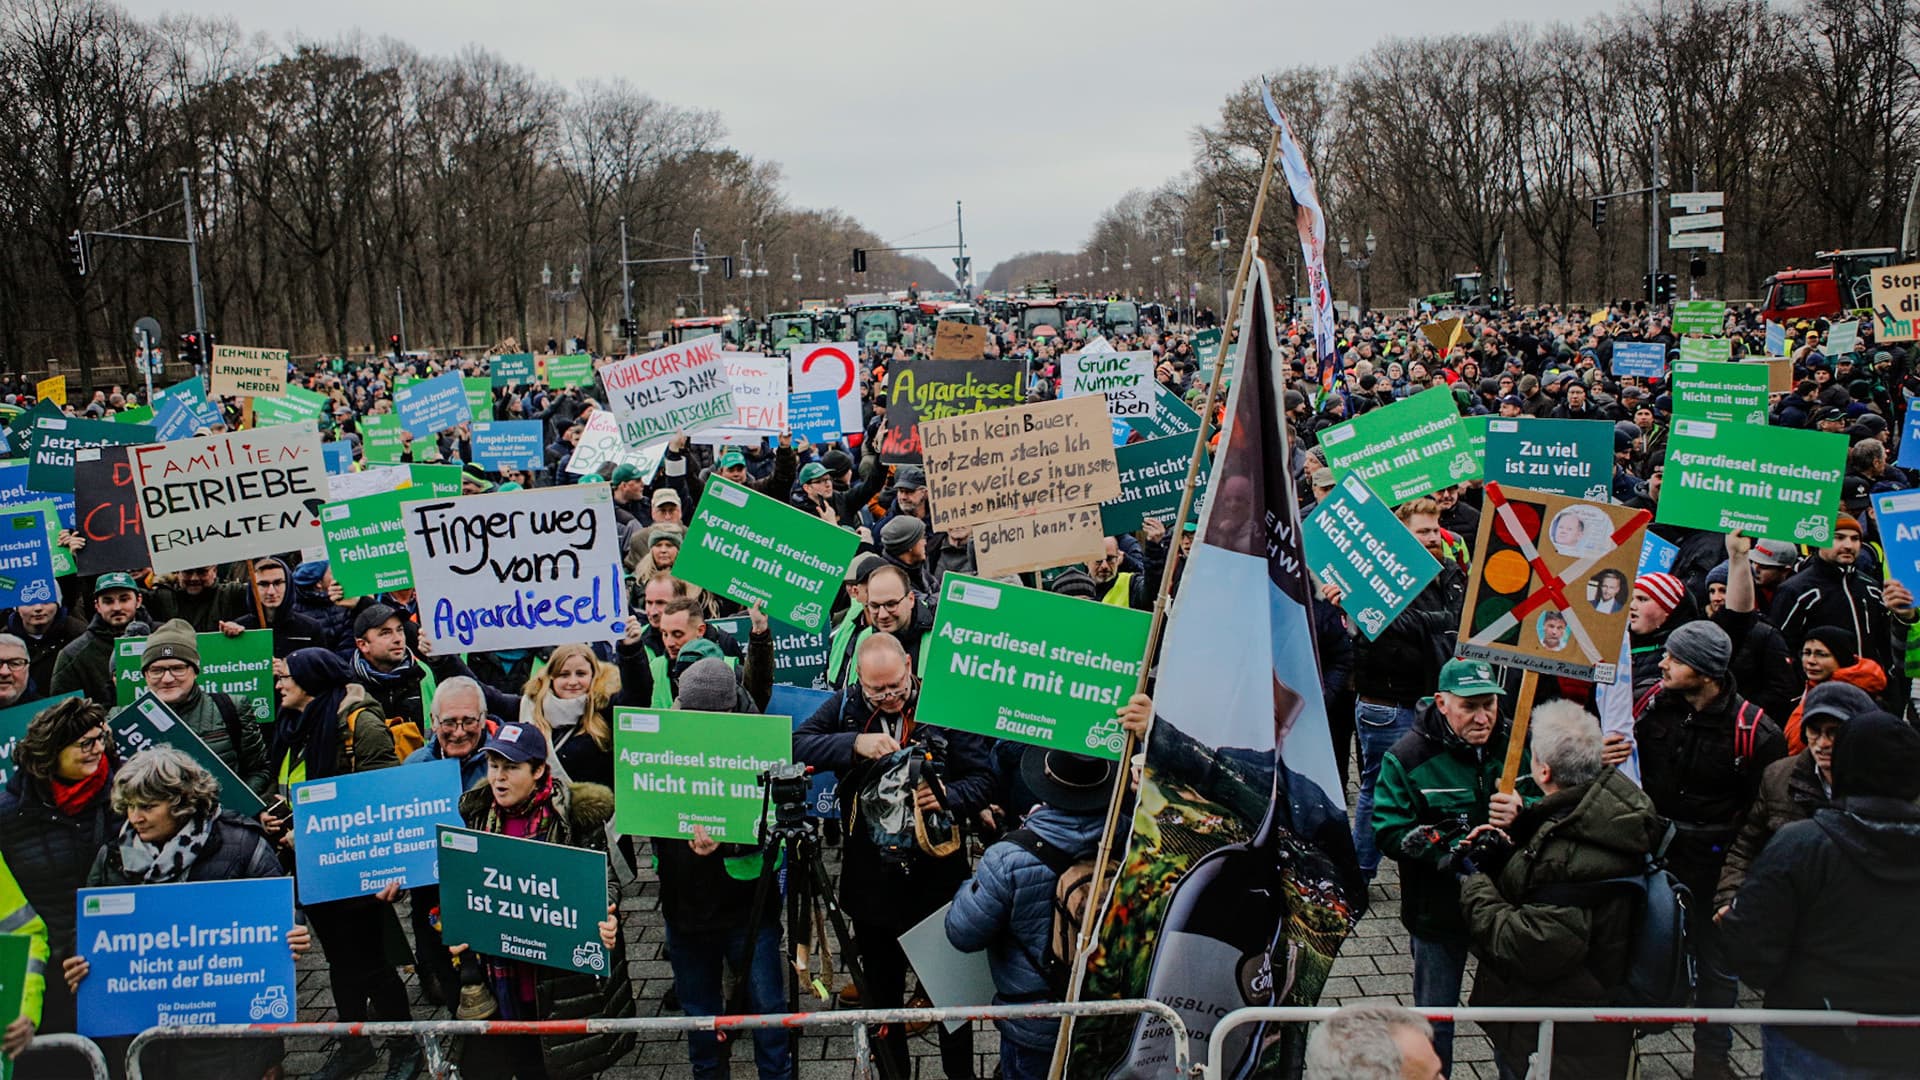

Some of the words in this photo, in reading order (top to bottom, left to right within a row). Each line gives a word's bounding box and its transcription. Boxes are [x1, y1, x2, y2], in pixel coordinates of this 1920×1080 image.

[218, 350, 236, 358] ICH
[240, 351, 258, 360] WILL
[262, 352, 288, 361] NOCH
[603, 342, 722, 392] KÜHLSCHRANK
[1078, 354, 1131, 374] Grüne
[625, 369, 728, 410] VOLL-DANK
[892, 369, 1026, 411] Agrardiesel
[1074, 374, 1145, 392] Nummer
[1110, 400, 1150, 415] iben
[1682, 392, 1712, 404] Nicht
[1714, 394, 1732, 404] mit
[1735, 396, 1758, 406] uns!
[619, 393, 733, 445] LANDWIRTSCHAFT
[923, 427, 947, 449] Ich
[952, 421, 980, 444] bin
[984, 415, 1020, 438] kein
[1333, 434, 1398, 469] Agrardiesel
[1400, 414, 1458, 444] streichen?
[36, 451, 74, 466] Nich
[926, 446, 1004, 474] trotzdem
[1010, 440, 1060, 461] stehe
[1065, 432, 1090, 452] Ich
[1393, 448, 1420, 469] mit
[1422, 434, 1456, 456] uns!
[1520, 441, 1542, 456] Zu
[1546, 442, 1578, 458] viel
[112, 462, 134, 487] D
[1506, 458, 1526, 474] ist
[1529, 463, 1549, 475] zu
[1554, 461, 1591, 478] viel!
[1670, 449, 1756, 472] Agrardiesel
[1760, 461, 1841, 483] streichen?
[142, 467, 316, 519] BETRIEBE
[433, 482, 459, 492] blick?
[1145, 480, 1172, 498] mit
[1175, 472, 1207, 491] us!
[1680, 472, 1734, 494] Nicht
[1739, 480, 1773, 499] mit
[1778, 489, 1822, 506] uns!
[932, 502, 967, 526] Land
[970, 502, 984, 514] so
[986, 489, 1020, 514] nicht
[1022, 482, 1094, 508] weiter
[84, 502, 140, 542] CH
[328, 526, 360, 542] Politik
[362, 522, 380, 533] mit
[1719, 517, 1768, 534] Bauern
[0, 540, 41, 552] rtschaft!
[340, 537, 408, 564] Fehlanzei
[414, 502, 524, 575] Finger
[530, 508, 596, 550] weg
[698, 509, 774, 550] Agrardiesel
[776, 542, 844, 578] streichen?
[980, 525, 1025, 554] gehen
[1330, 498, 1364, 536] Jetzt
[1360, 531, 1416, 590] reicht's!
[490, 549, 580, 583] vom
[701, 532, 750, 566] Nicht
[752, 554, 784, 578] mit
[785, 570, 824, 594] uns!
[1315, 510, 1352, 554] Nicht
[1347, 549, 1375, 578] mit
[1369, 573, 1404, 609] uns!
[377, 576, 409, 588] Bauern
[796, 651, 827, 666] uns!
[940, 620, 1047, 658] Agrardiesel
[1051, 646, 1144, 677] streichen?
[203, 658, 270, 674] streichen?
[1558, 662, 1594, 678] Raum!
[222, 678, 258, 692] uns!
[950, 652, 1017, 685] Nicht
[1022, 671, 1064, 695] mit
[1070, 680, 1122, 706] uns!
[995, 716, 1054, 740] Bauern
[998, 706, 1012, 716] Die
[1014, 710, 1057, 726] Deutschen
[620, 748, 705, 768] Agrardiesel
[633, 772, 686, 794] Nicht
[692, 777, 724, 796] mit
[731, 784, 766, 800] uns
[306, 797, 452, 834] Ampel-Irrsinn:
[678, 812, 690, 820] Die
[690, 813, 727, 823] Deutschen
[336, 834, 370, 850] Nicht
[374, 830, 394, 844] auf
[396, 826, 424, 840] dem
[678, 821, 727, 836] Baern
[319, 850, 366, 866] Rücken
[370, 846, 390, 858] der
[394, 838, 437, 854] Bauern
[360, 870, 371, 878] Die
[372, 866, 407, 876] Deutschen
[360, 874, 407, 892] Bauern
[483, 866, 512, 892] Zu
[518, 874, 560, 900] viel
[467, 888, 492, 913] ist
[498, 900, 524, 920] zu
[530, 905, 578, 929] viel!
[92, 921, 278, 956] Ampel-Irrsinn:
[500, 932, 512, 942] Die
[512, 935, 547, 948] Deutschen
[502, 942, 548, 960] Bauern
[130, 958, 174, 974] Nicht
[178, 956, 204, 972] auf
[208, 954, 243, 969] dem
[107, 976, 167, 993] Rücken
[172, 974, 199, 990] der
[203, 970, 266, 986] Bauern!
[158, 1002, 172, 1012] Die
[174, 1000, 217, 1011] Deutschen
[158, 1011, 216, 1026] Bauern
